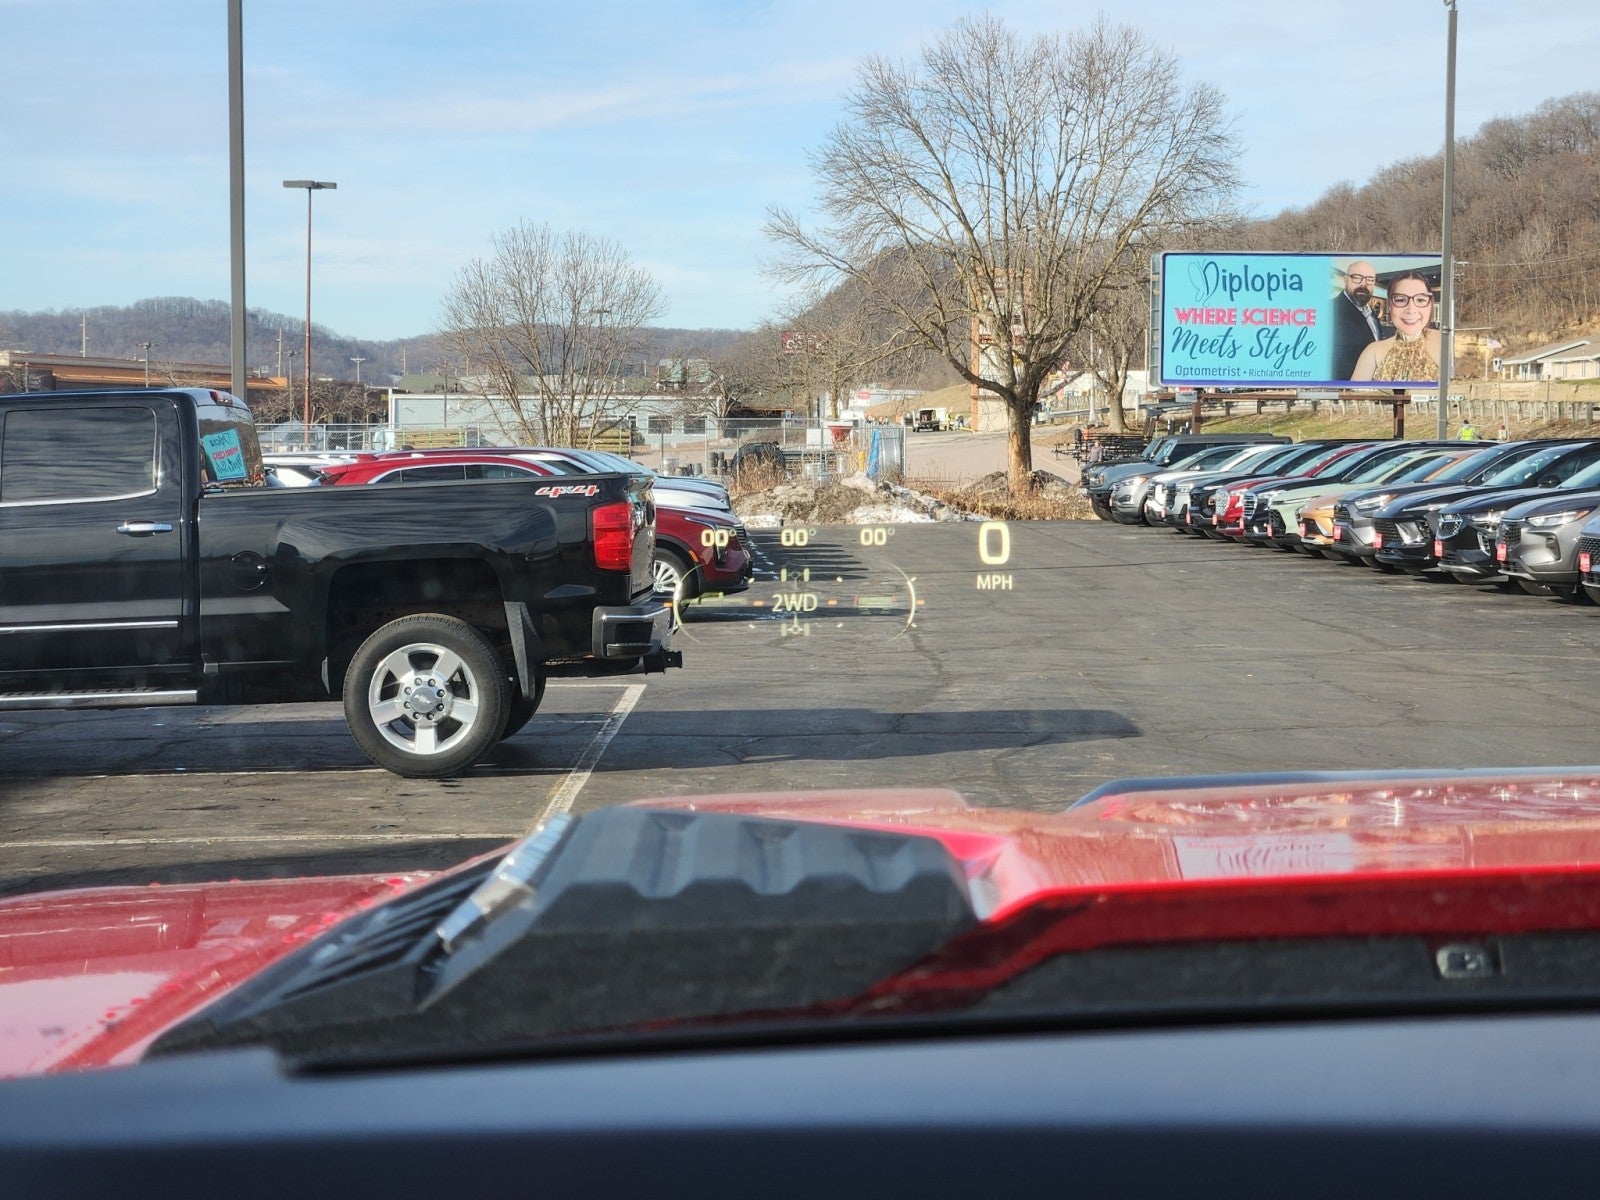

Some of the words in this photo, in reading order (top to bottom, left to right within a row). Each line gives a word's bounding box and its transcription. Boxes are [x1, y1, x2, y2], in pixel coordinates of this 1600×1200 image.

[1200, 260, 1303, 303] Diplopia
[1173, 307, 1237, 326] WHERE
[1240, 307, 1316, 326] SCIENCE
[1171, 326, 1243, 360] Meets
[1249, 326, 1318, 370] Style
[1175, 364, 1242, 378] Optometrist
[1248, 368, 1283, 377] Richland
[1285, 368, 1312, 378] Center
[978, 520, 1011, 565] 0
[976, 574, 1014, 590] MPH
[771, 593, 818, 613] 2WD
